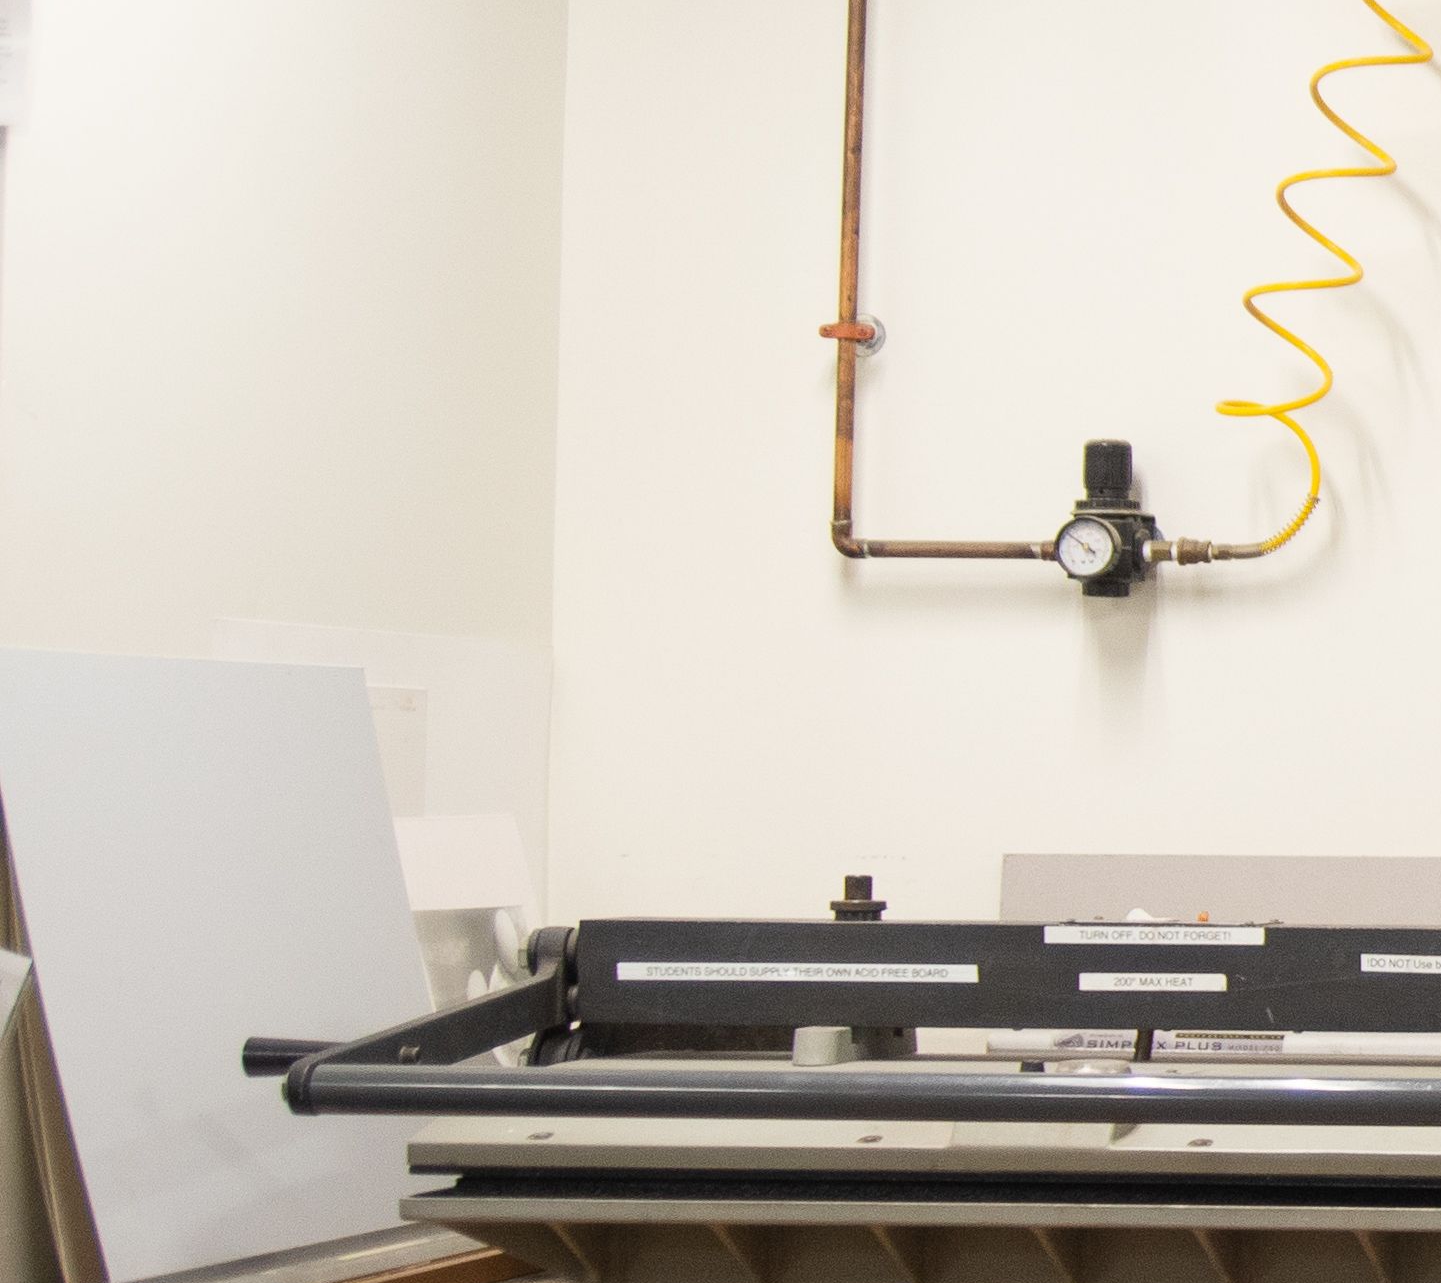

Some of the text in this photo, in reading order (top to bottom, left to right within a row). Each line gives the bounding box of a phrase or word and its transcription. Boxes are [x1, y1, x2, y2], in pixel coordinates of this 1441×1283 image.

[1079, 930, 1110, 941] TURN
[1139, 931, 1154, 941] DO
[1156, 931, 1182, 941] NOT
[1183, 931, 1232, 942] FORGET!
[1388, 959, 1412, 969] NOT
[1413, 959, 1433, 970] Use
[645, 965, 949, 979] STUDENTS SHOULD SUPPLY THEIR OWN ACID FREE BOARD
[1139, 977, 1163, 988] MAX
[1165, 978, 1194, 988] HEAT
[1086, 1039, 1167, 1050] SIMPX
[1174, 1040, 1222, 1051] PLUS
